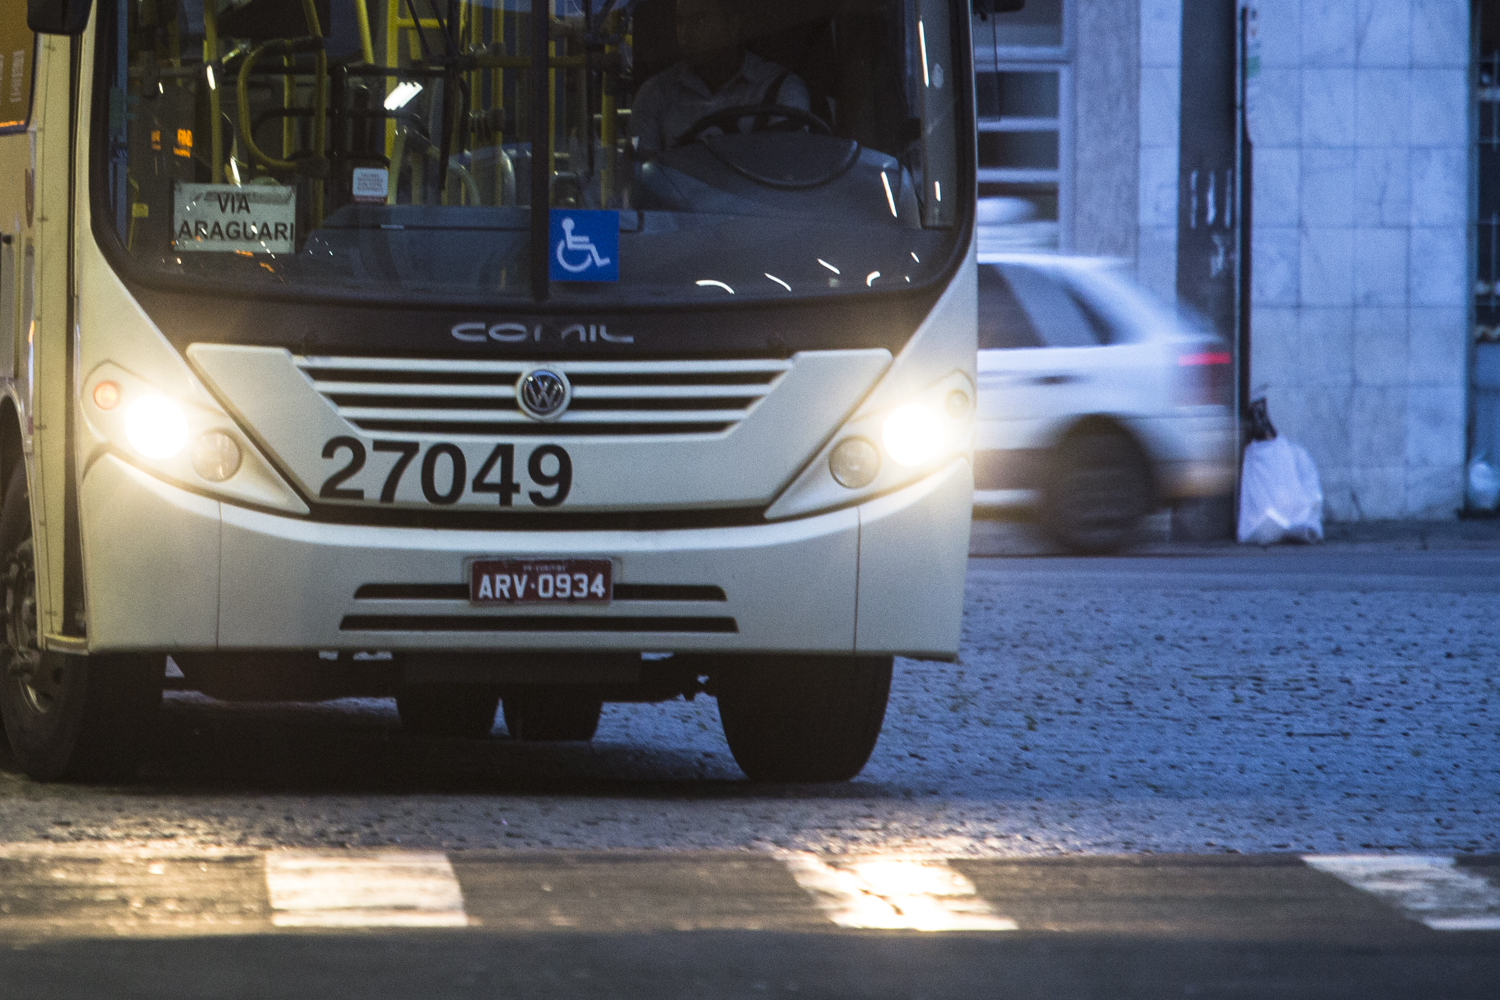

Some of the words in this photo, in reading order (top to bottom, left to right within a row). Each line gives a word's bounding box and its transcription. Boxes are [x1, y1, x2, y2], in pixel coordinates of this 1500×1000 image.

[216, 192, 252, 214] VIA
[178, 220, 295, 242] ARAGUARI
[318, 435, 574, 508] 27049
